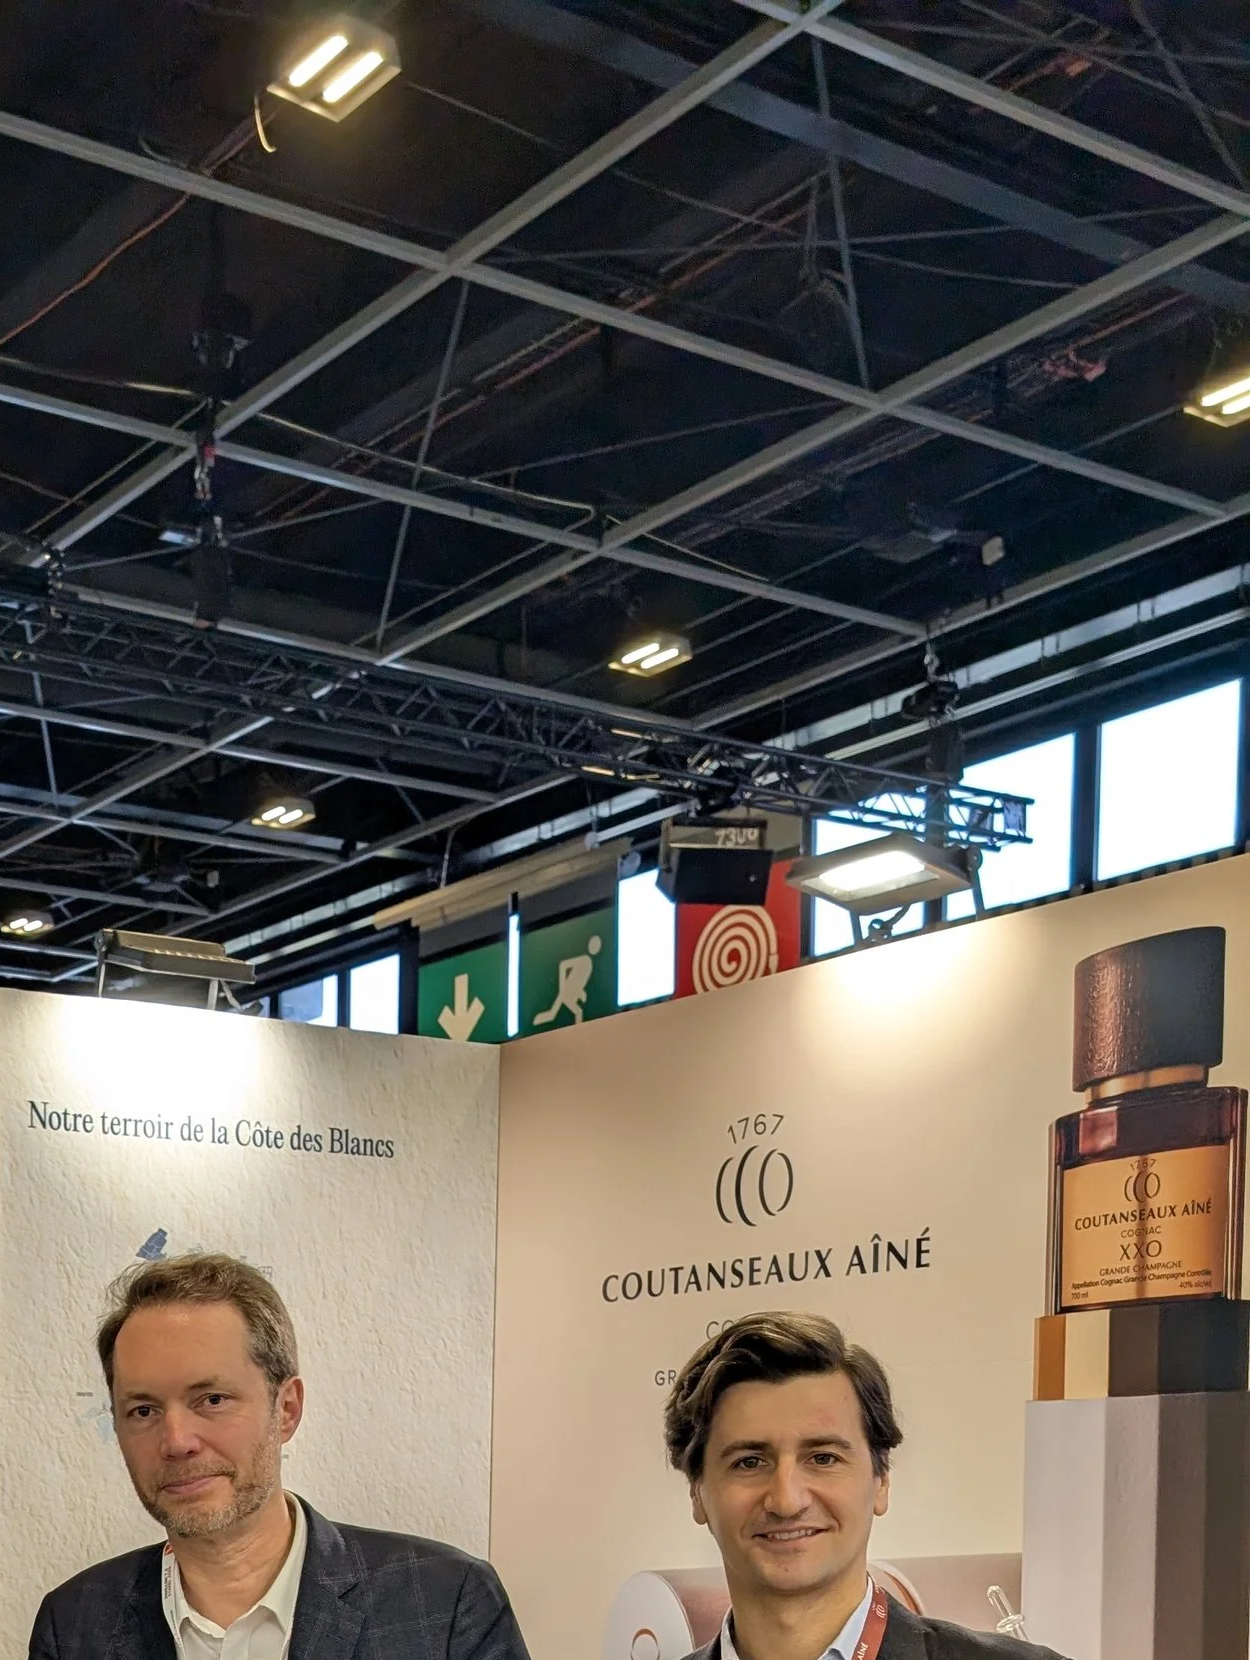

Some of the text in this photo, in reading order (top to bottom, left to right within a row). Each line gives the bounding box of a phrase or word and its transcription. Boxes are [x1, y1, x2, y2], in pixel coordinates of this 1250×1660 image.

[28, 1100, 395, 1158] Notre terroir de la Côte des Blancs
[727, 1113, 785, 1144] 1767
[1129, 1158, 1157, 1171] 1767
[1074, 1198, 1212, 1231] COUTANSEAUX AÎNÉ
[1120, 1225, 1162, 1239] COGNAC
[1119, 1239, 1162, 1261] XXO
[602, 1226, 932, 1303] COUTANSEAUX AÎNÉ
[1099, 1260, 1182, 1276] GRANDE CHAMPAGNE
[1100, 1276, 1123, 1287] Cognac
